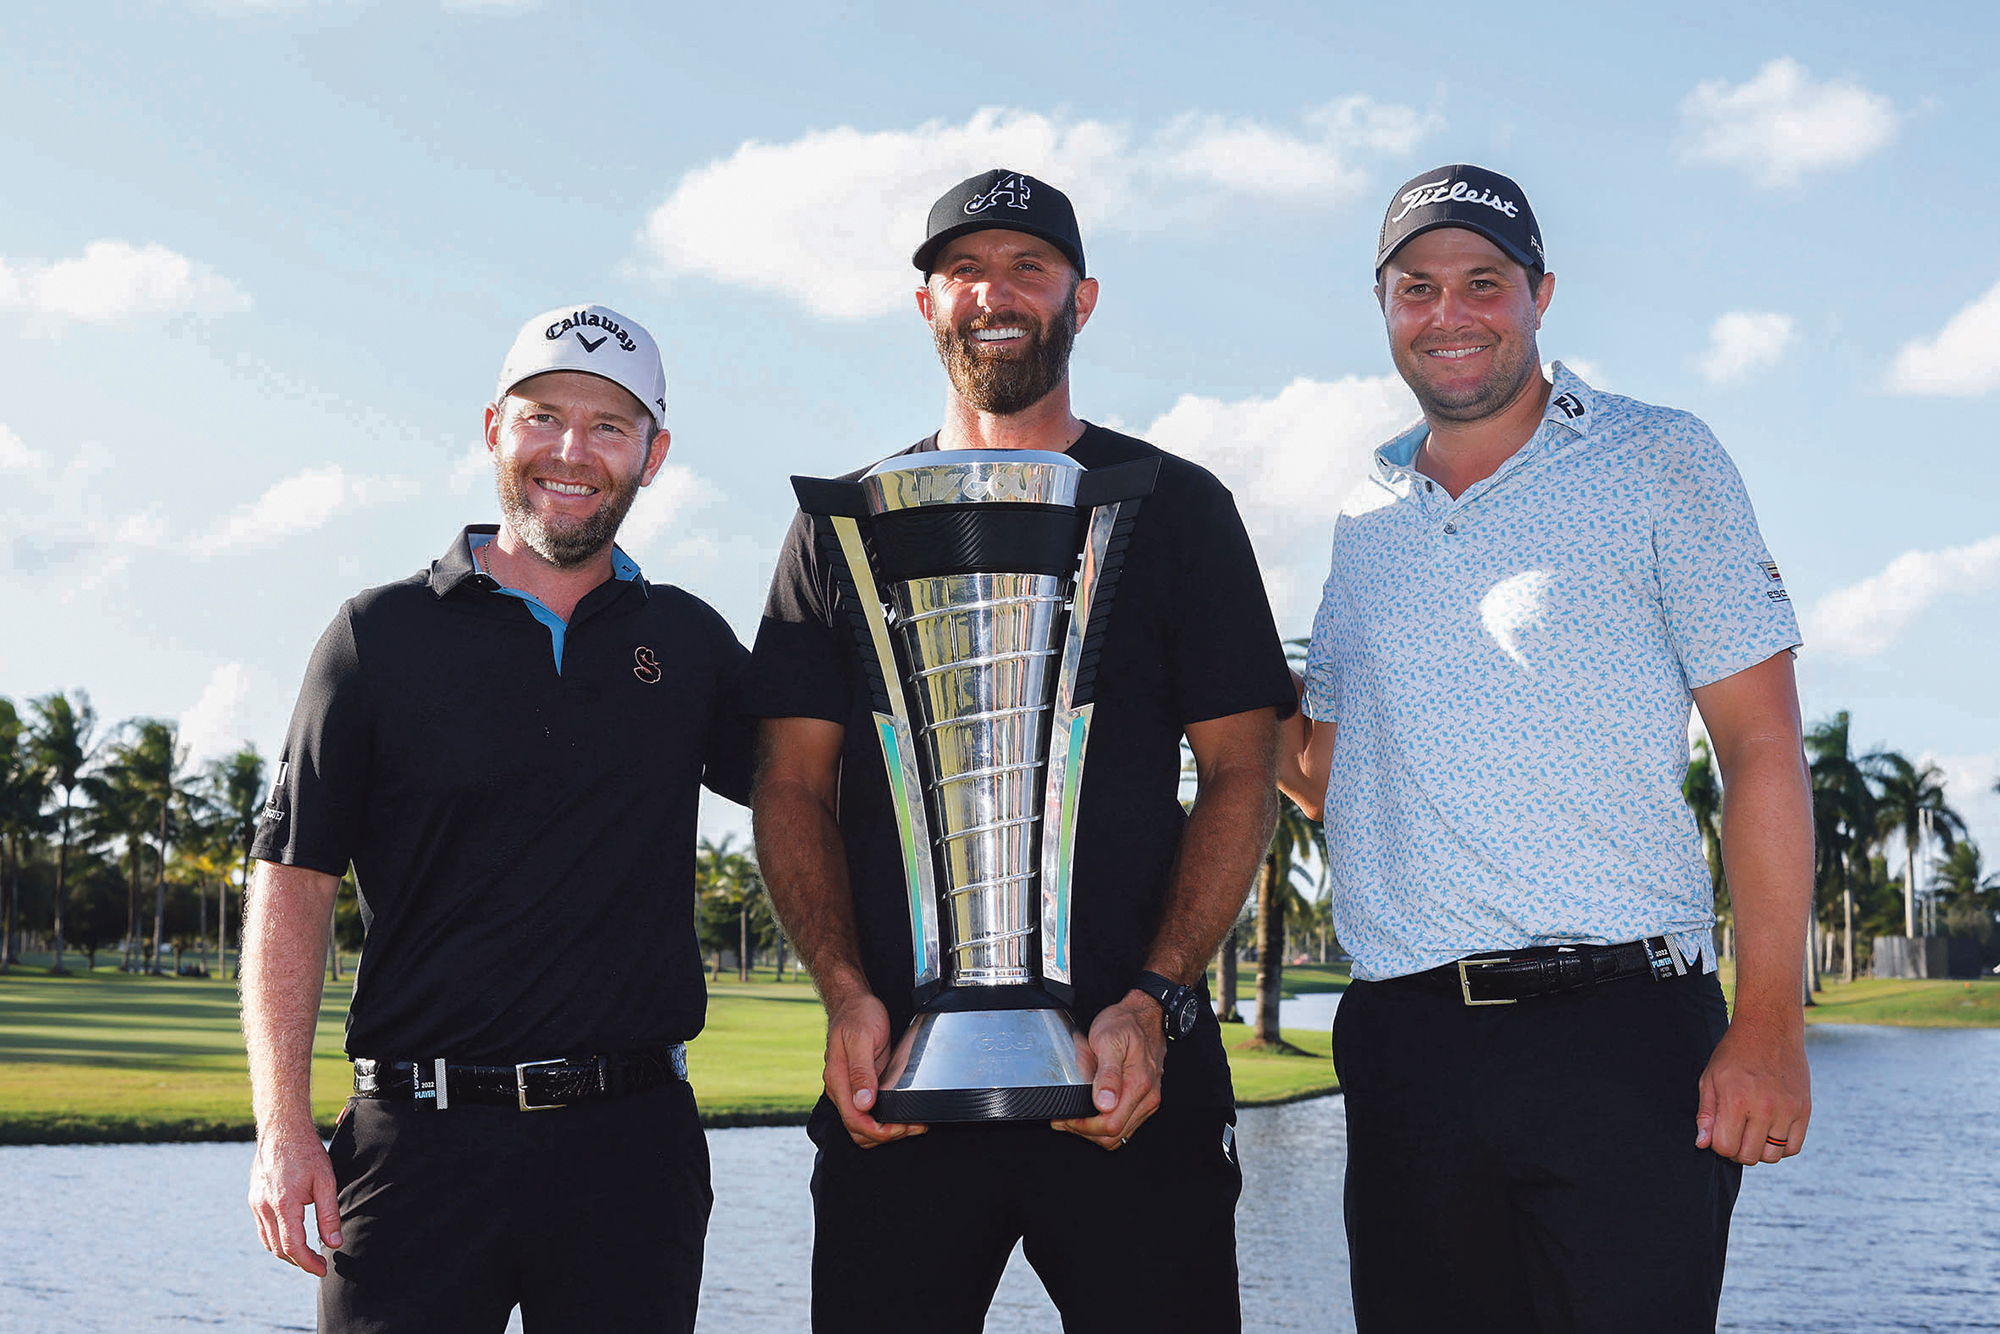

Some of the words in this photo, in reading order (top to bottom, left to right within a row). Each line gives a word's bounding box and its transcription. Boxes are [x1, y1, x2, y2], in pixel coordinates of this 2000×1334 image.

[1392, 178, 1519, 224] Titleist
[545, 310, 637, 352] Callaway
[962, 472, 1042, 500] GOLF
[1655, 949, 1668, 957] 2022
[1651, 957, 1673, 969] PLAYER
[421, 1081, 435, 1089] 2022
[414, 1090, 436, 1099] PLAYER
